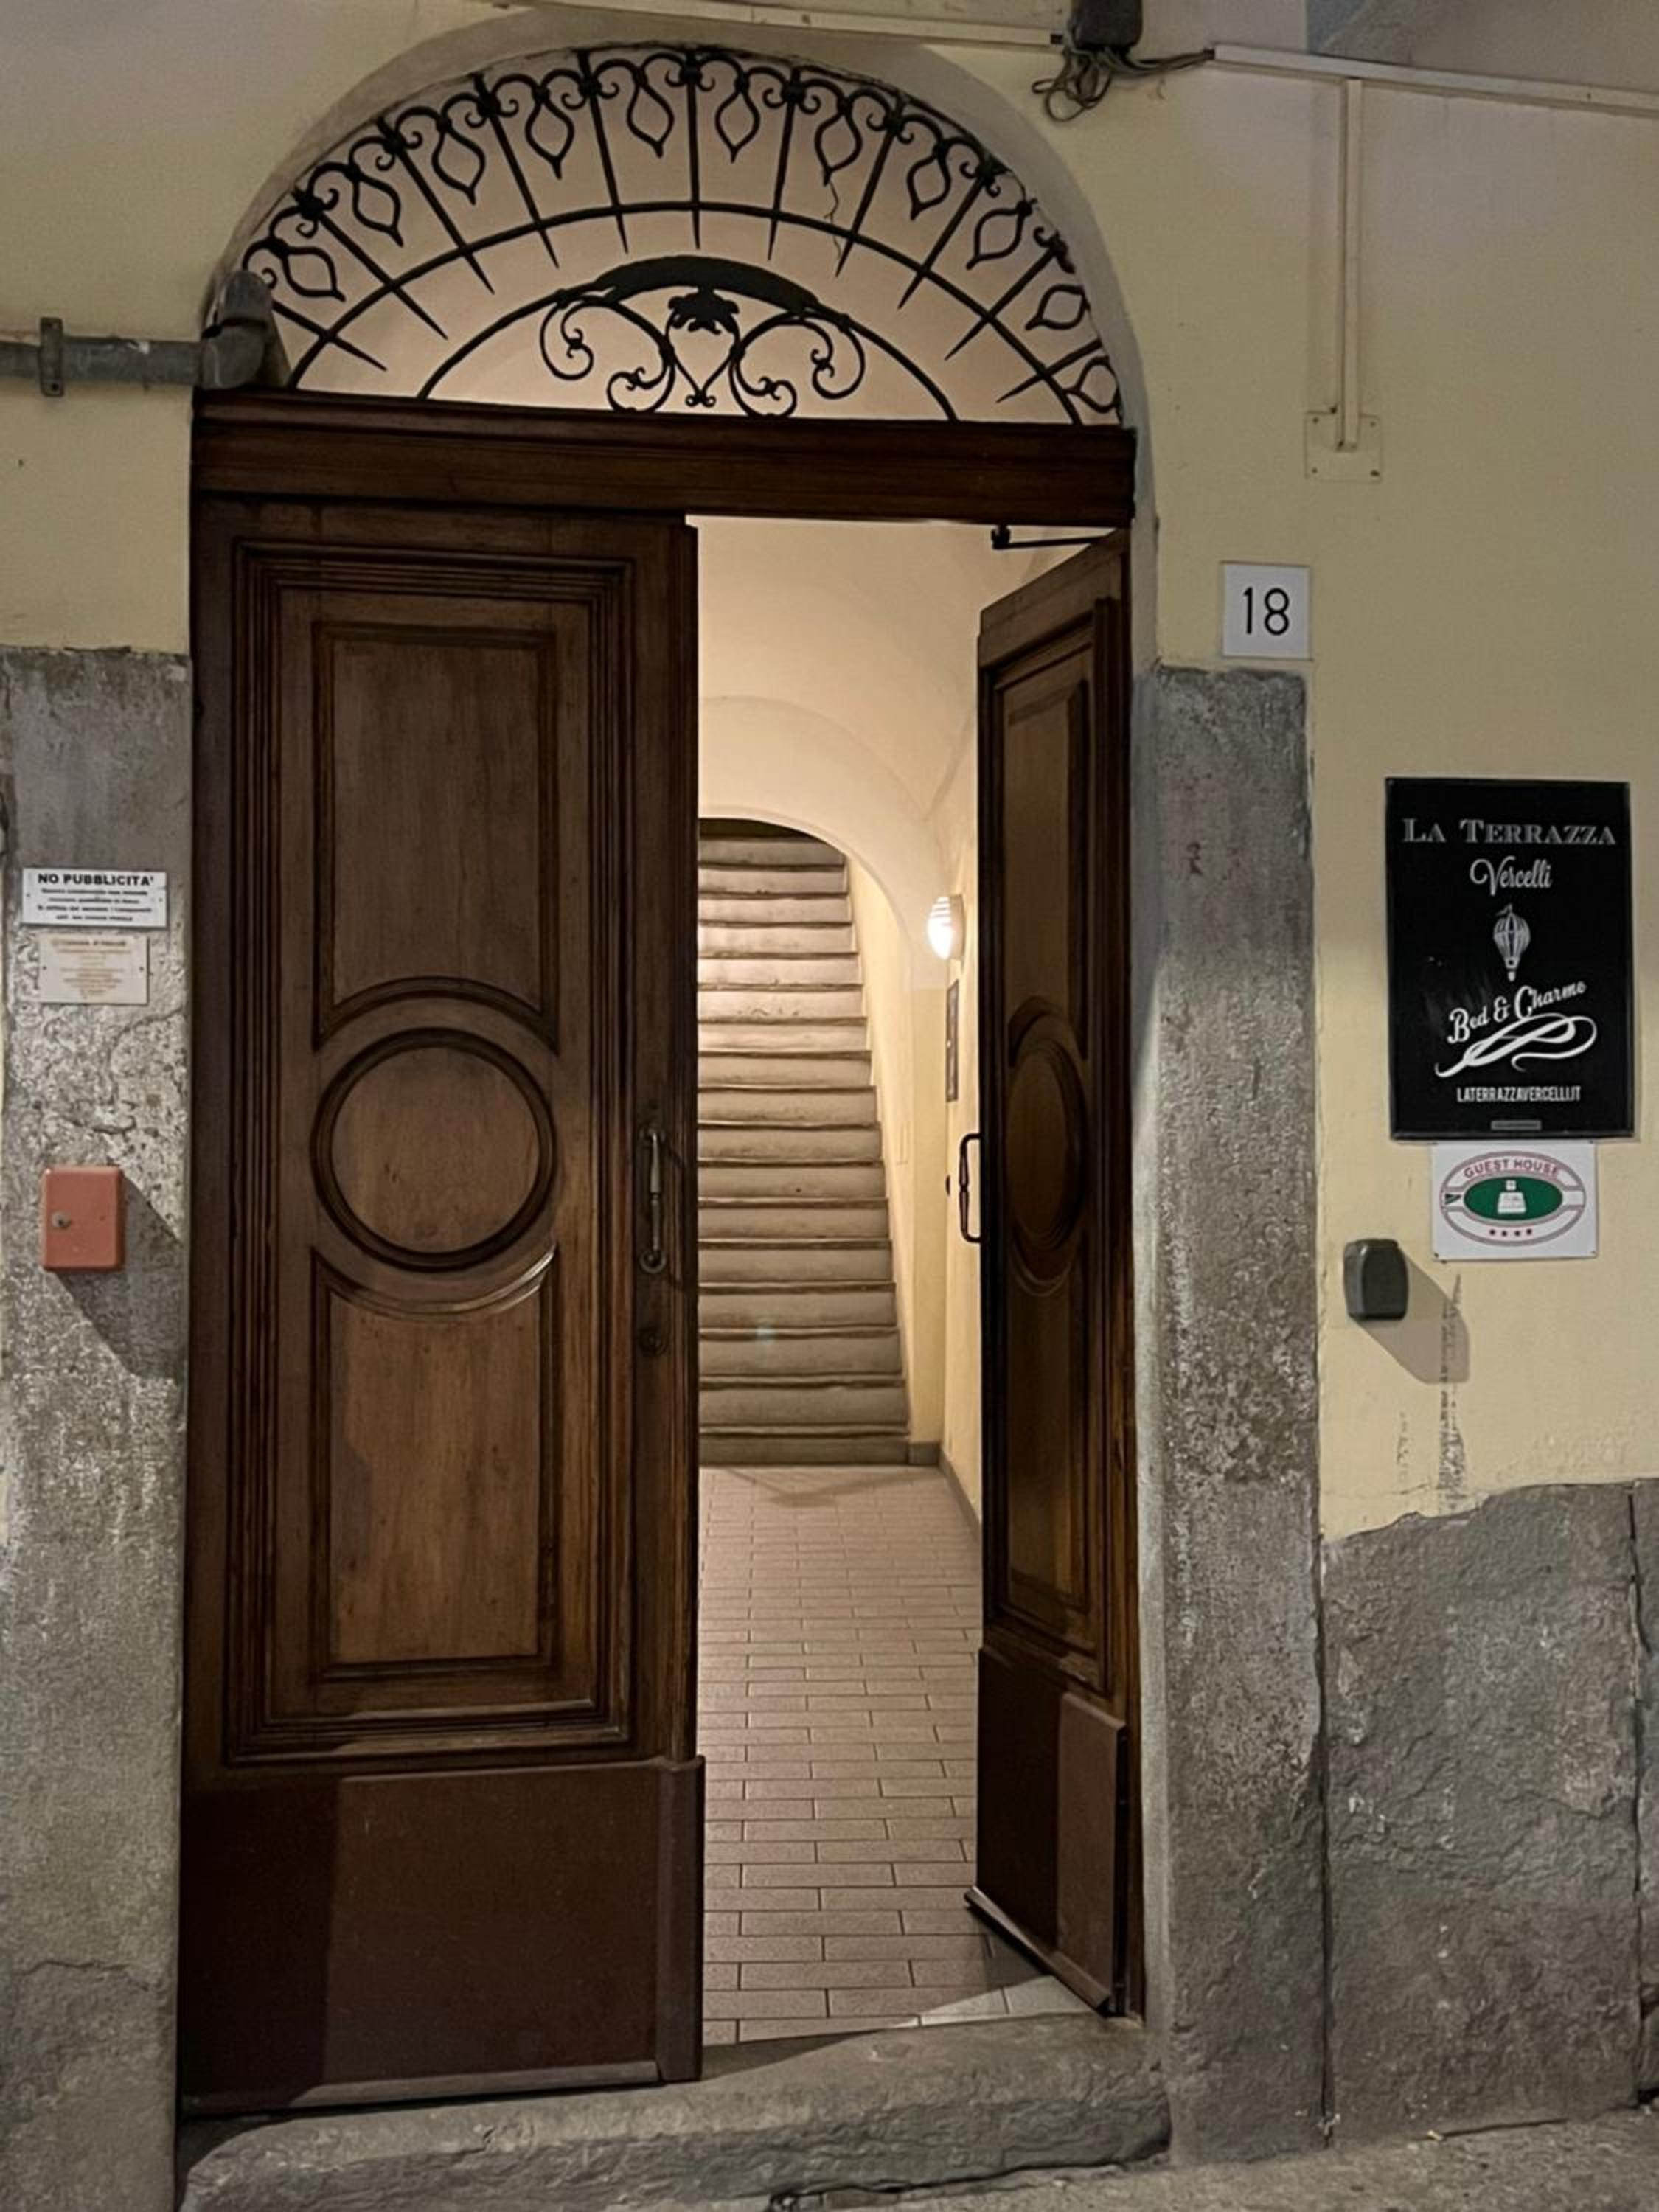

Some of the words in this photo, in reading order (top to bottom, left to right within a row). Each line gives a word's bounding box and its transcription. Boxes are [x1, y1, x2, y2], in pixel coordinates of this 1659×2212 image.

[1243, 586, 1290, 636] 18
[38, 874, 58, 884] NO
[63, 874, 153, 886] PUBBLICITA'
[1469, 855, 1553, 896] Vercelli
[1447, 1007, 1490, 1045] Bed
[1493, 996, 1511, 1022] &
[1514, 980, 1587, 1020] Charme
[1464, 1159, 1509, 1178] GUEST
[1514, 1158, 1559, 1178] HOUSE
